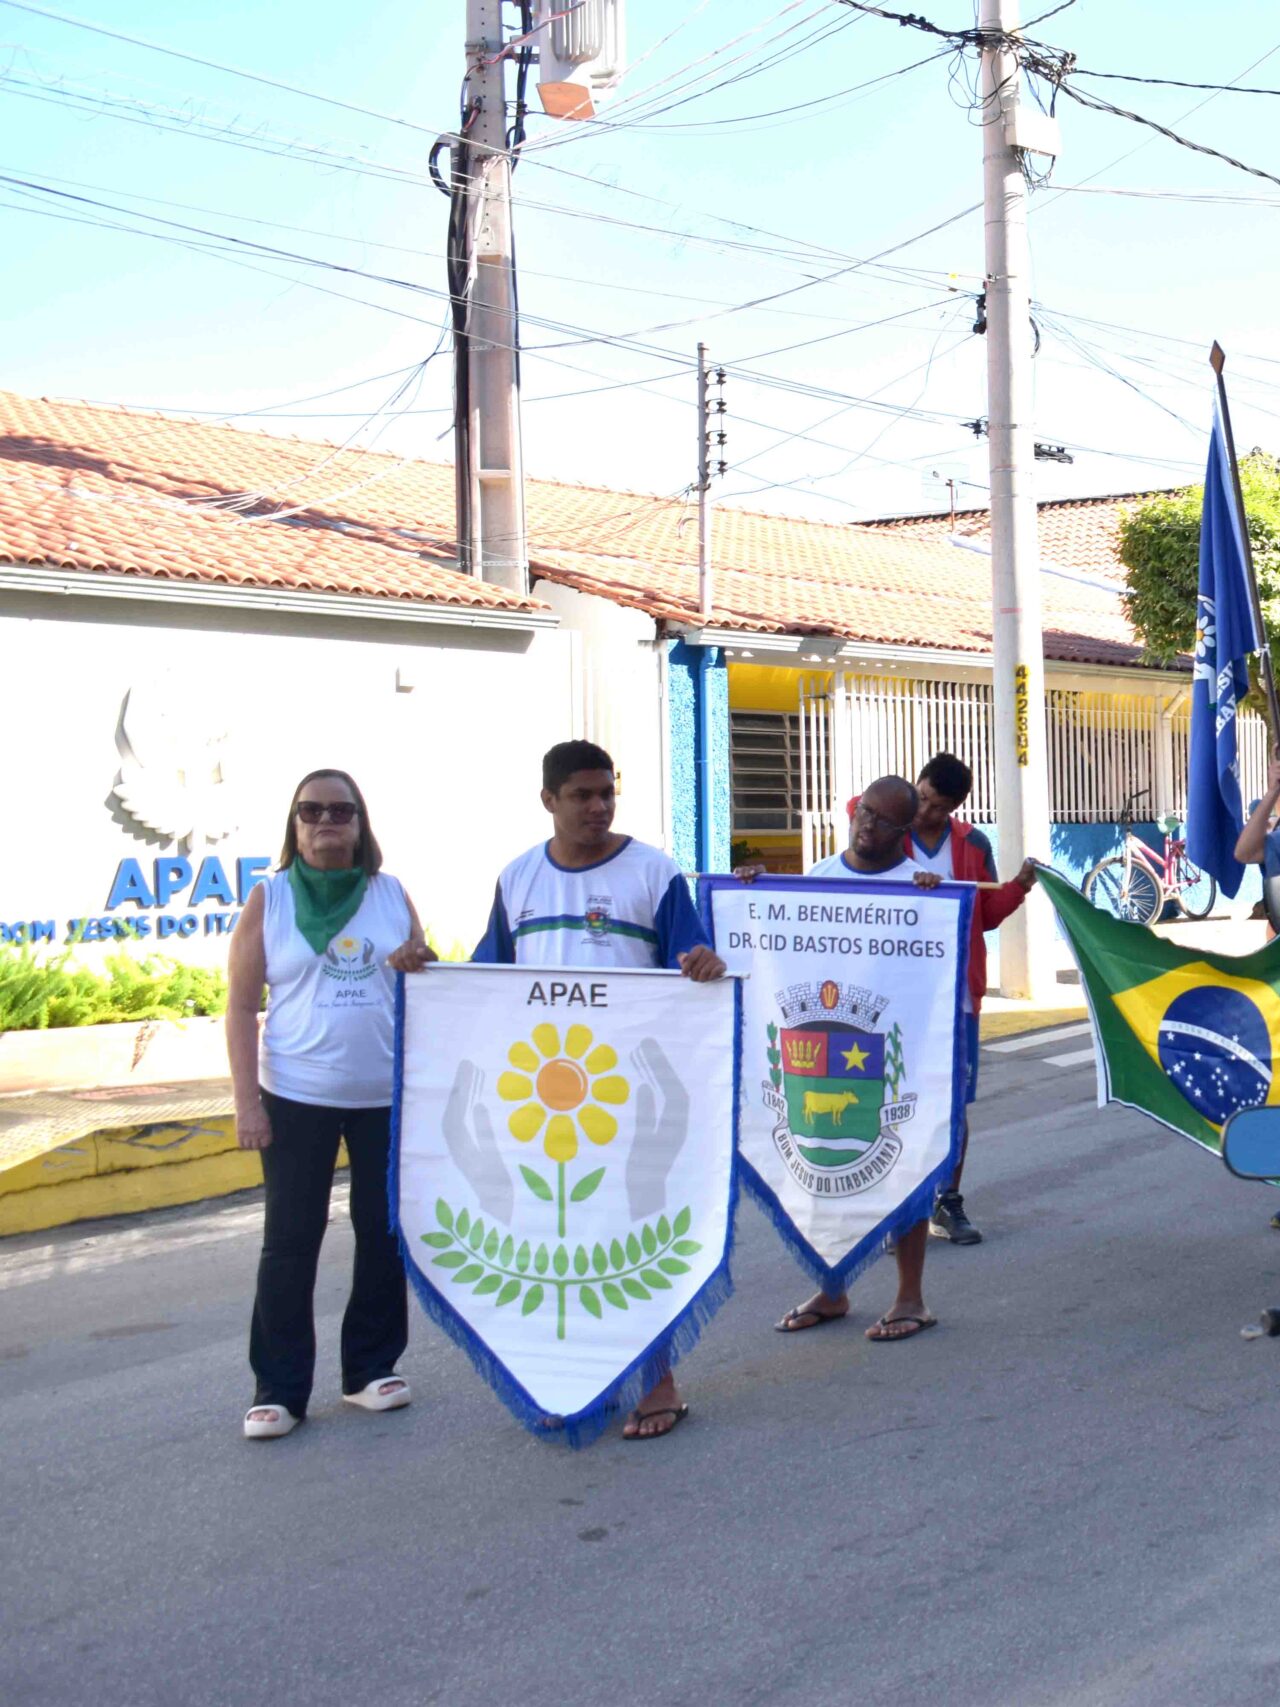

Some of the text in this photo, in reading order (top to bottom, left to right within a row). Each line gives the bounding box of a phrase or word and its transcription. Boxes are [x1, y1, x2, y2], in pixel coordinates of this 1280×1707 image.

[748, 902, 919, 926] E. M. BENEMÉRITO
[157, 914, 199, 940] DO
[793, 935, 863, 954] BASTOS
[868, 939, 945, 958] BORGES
[335, 988, 369, 999] APAE
[526, 980, 609, 1008] APAE
[766, 1091, 786, 1115] 1842
[883, 1103, 912, 1123] 1938
[777, 1132, 899, 1194] BOM JESUS DO ITABAPOANA
